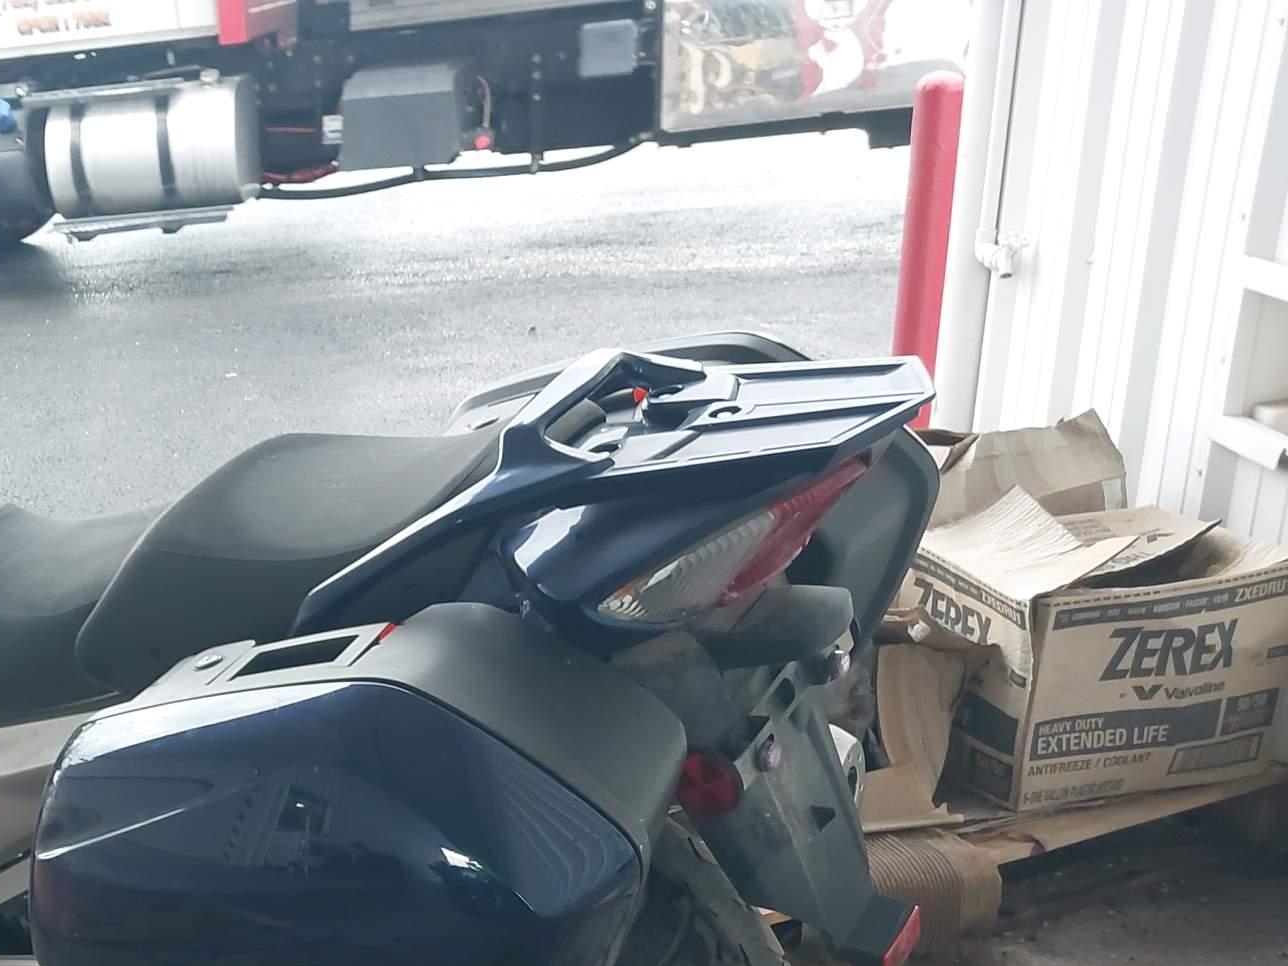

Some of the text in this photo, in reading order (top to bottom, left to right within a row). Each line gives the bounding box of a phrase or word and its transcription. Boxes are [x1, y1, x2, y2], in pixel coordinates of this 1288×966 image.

[1099, 618, 1238, 682] ZEREX
[1165, 681, 1225, 700] Valvoline
[1038, 717, 1105, 735] HEAVY DUTY
[1037, 725, 1170, 755] EXTENDED LIFE
[1027, 759, 1093, 777] ANTIFREEZE
[1103, 752, 1153, 768] COOLANT
